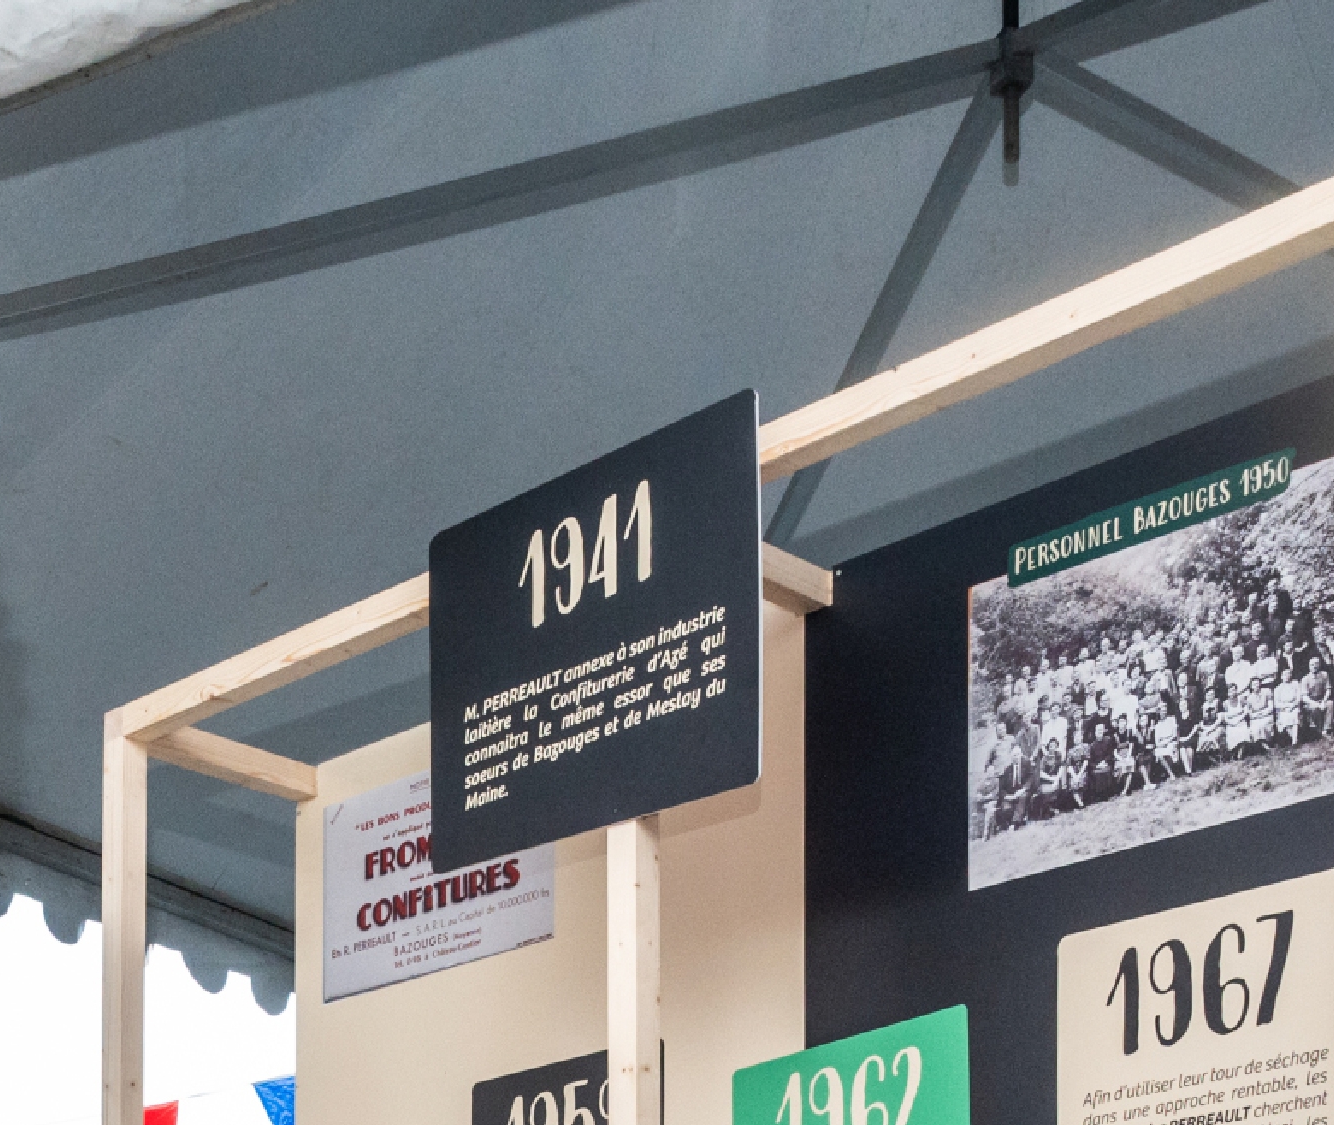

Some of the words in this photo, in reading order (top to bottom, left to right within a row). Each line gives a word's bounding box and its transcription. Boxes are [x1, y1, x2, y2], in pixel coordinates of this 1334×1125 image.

[518, 478, 653, 628] 1941
[1014, 522, 1123, 575] PERSONNEL
[1133, 479, 1231, 536] BAZOUGES
[1238, 456, 1289, 498] 1950
[465, 705, 479, 722] M.
[483, 669, 561, 715] PERREAULT
[564, 652, 614, 683] annexe
[617, 642, 626, 660] à
[629, 636, 655, 657] son
[658, 606, 725, 645] industrie
[465, 715, 511, 744] laitière
[525, 705, 537, 720] la
[551, 666, 635, 710] Confiturerie
[648, 640, 688, 672] d'Azé
[701, 626, 725, 655] qui
[539, 722, 551, 737] le
[561, 702, 604, 729] même
[614, 683, 653, 708] essor
[664, 669, 691, 693] que
[701, 655, 725, 676] ses
[465, 761, 508, 789] soeurs
[513, 753, 528, 770] de
[534, 727, 599, 763] Bazouges
[605, 717, 619, 736] et
[624, 710, 641, 729] de
[646, 688, 701, 720] Meslay
[706, 678, 725, 698] du
[465, 785, 508, 811] Maine.
[357, 858, 521, 932] CONFITURES
[1106, 910, 1293, 1056] 1967
[1083, 1090, 1110, 1109] Afin
[1114, 1080, 1175, 1100] d'utiliser
[1179, 1073, 1207, 1088] leur
[1211, 1066, 1242, 1081] tour
[1245, 1059, 1262, 1074] de
[1266, 1049, 1329, 1071] séchage
[1124, 1105, 1150, 1121] une
[1156, 1090, 1225, 1116] approche
[1232, 1076, 1297, 1098] rentable,
[1307, 1071, 1327, 1085] les
[1254, 1090, 1327, 1117] cherchent
